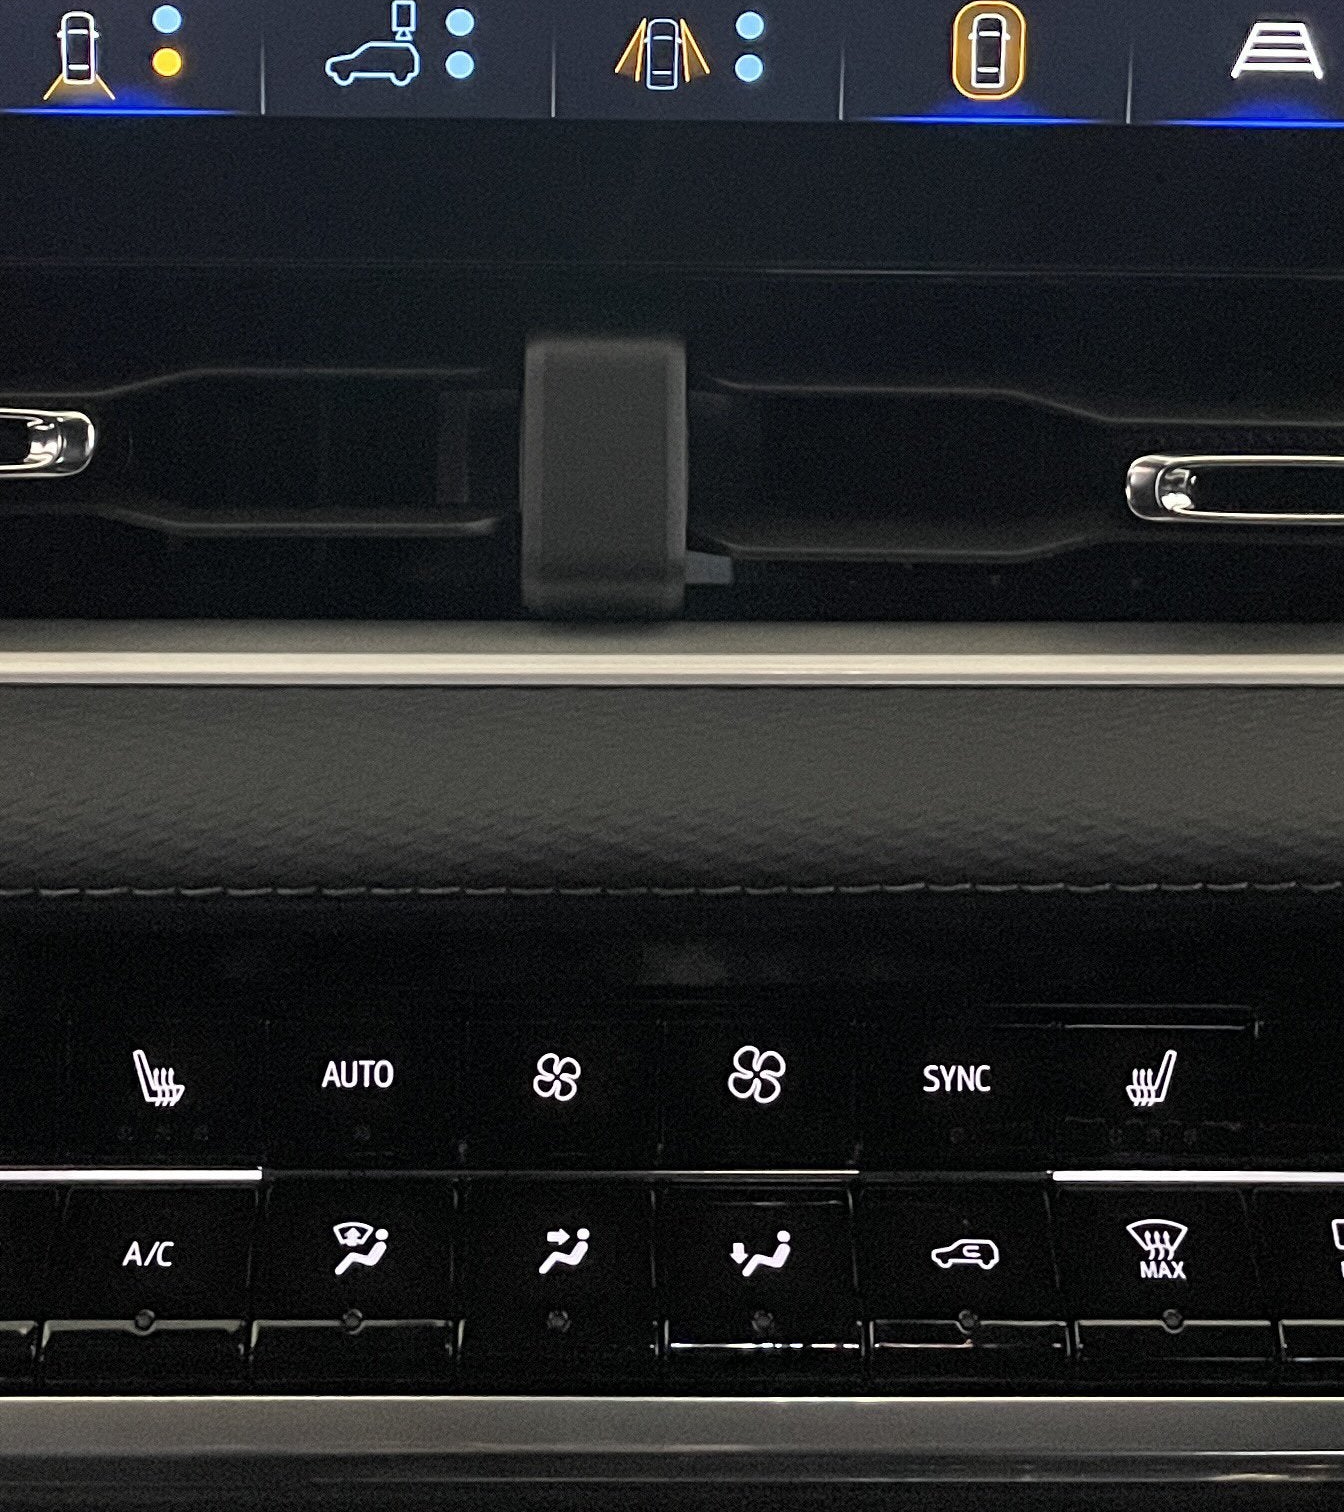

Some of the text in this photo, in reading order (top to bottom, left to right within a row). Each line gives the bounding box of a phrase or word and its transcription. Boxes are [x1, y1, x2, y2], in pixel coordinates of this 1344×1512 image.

[321, 1059, 395, 1089] AUTO
[922, 1064, 992, 1092] SYNC
[121, 1239, 175, 1267] A/C
[1139, 1260, 1187, 1281] MAX
